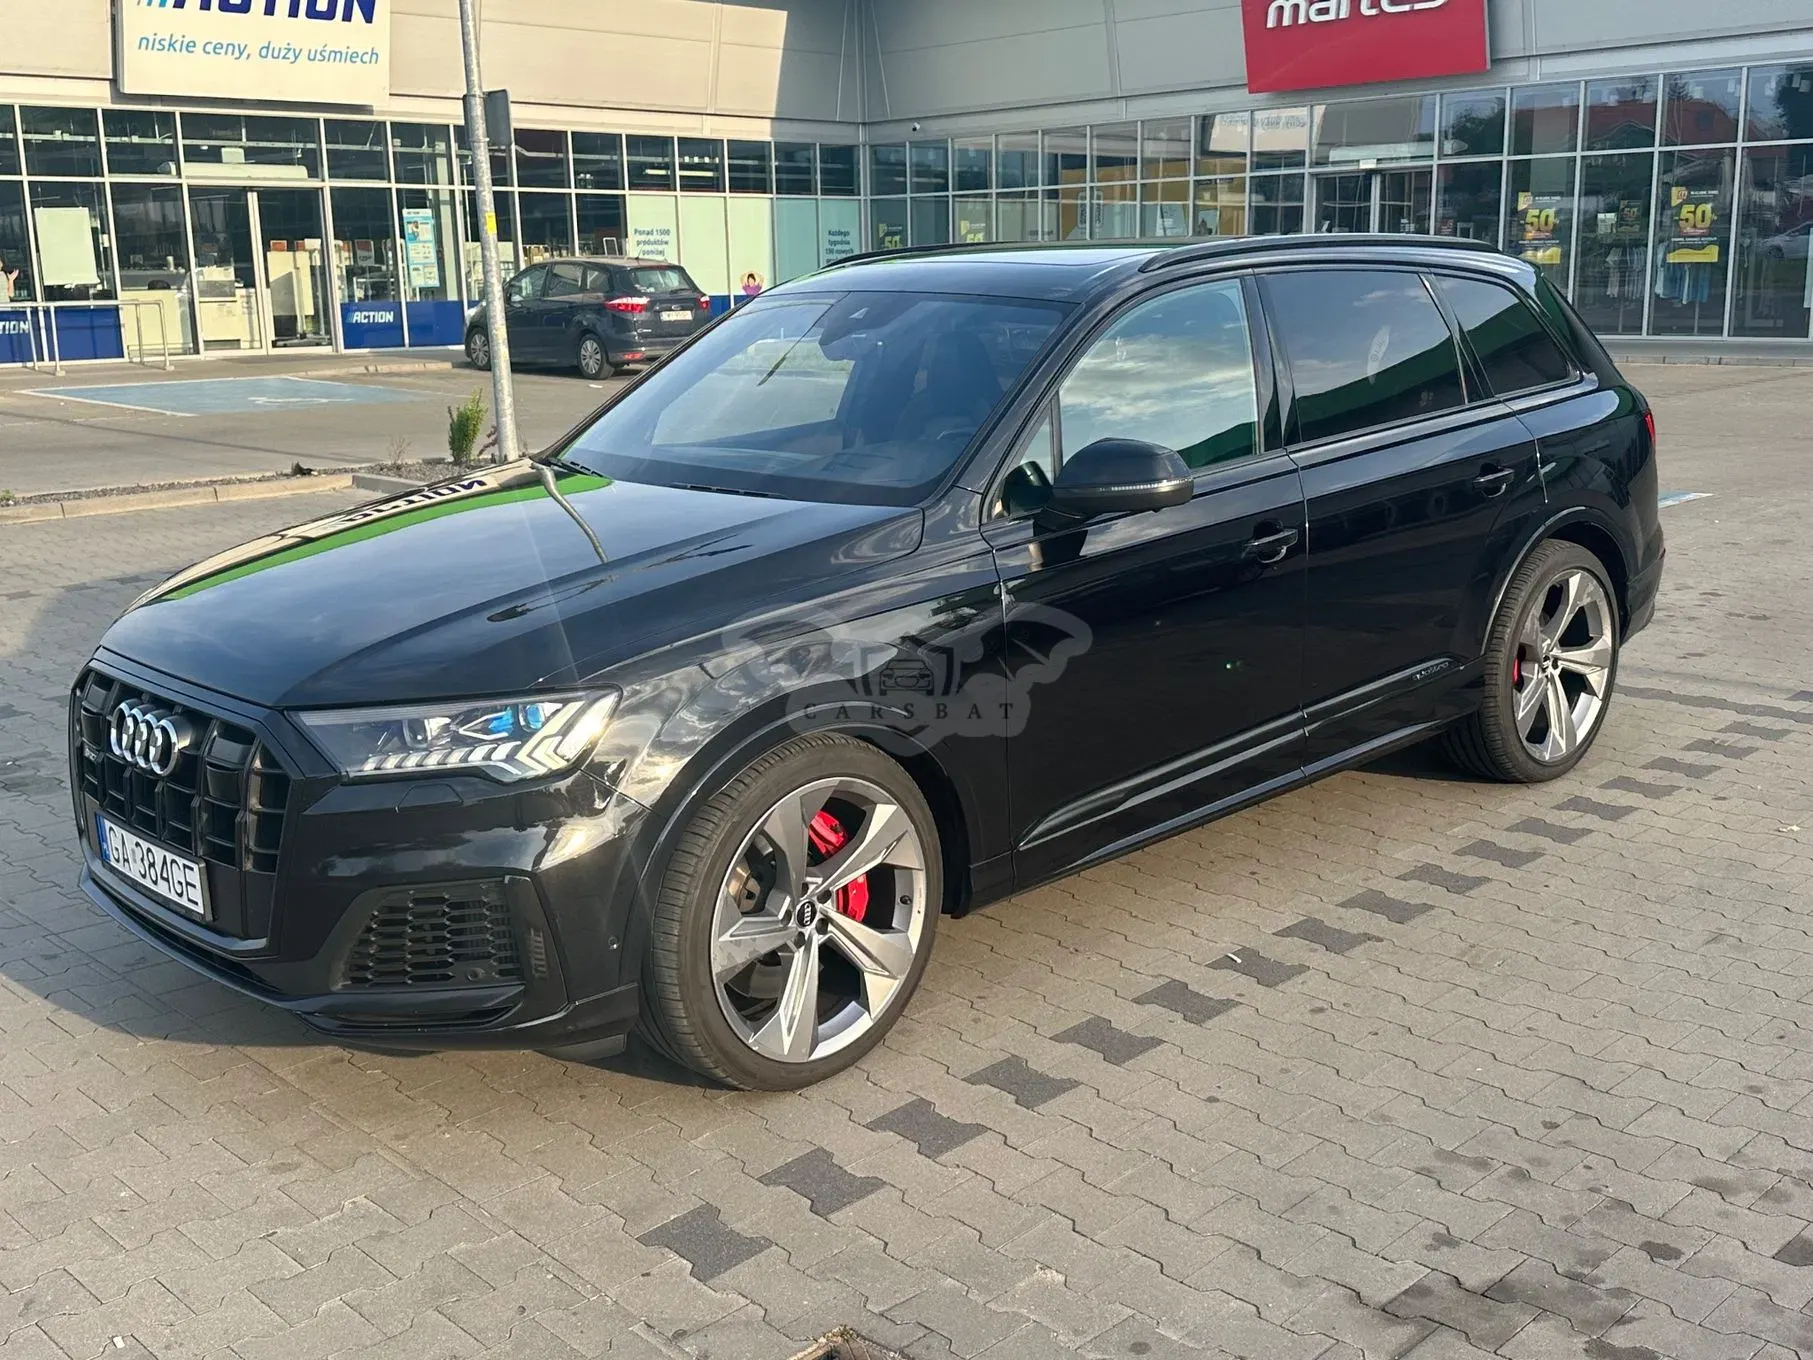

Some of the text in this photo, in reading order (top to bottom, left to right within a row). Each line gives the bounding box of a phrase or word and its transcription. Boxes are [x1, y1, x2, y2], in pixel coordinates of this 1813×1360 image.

[137, 33, 379, 65] niskie ceny, duży uśmiech
[353, 311, 394, 323] ACTION
[109, 826, 199, 906] GA 384GE
